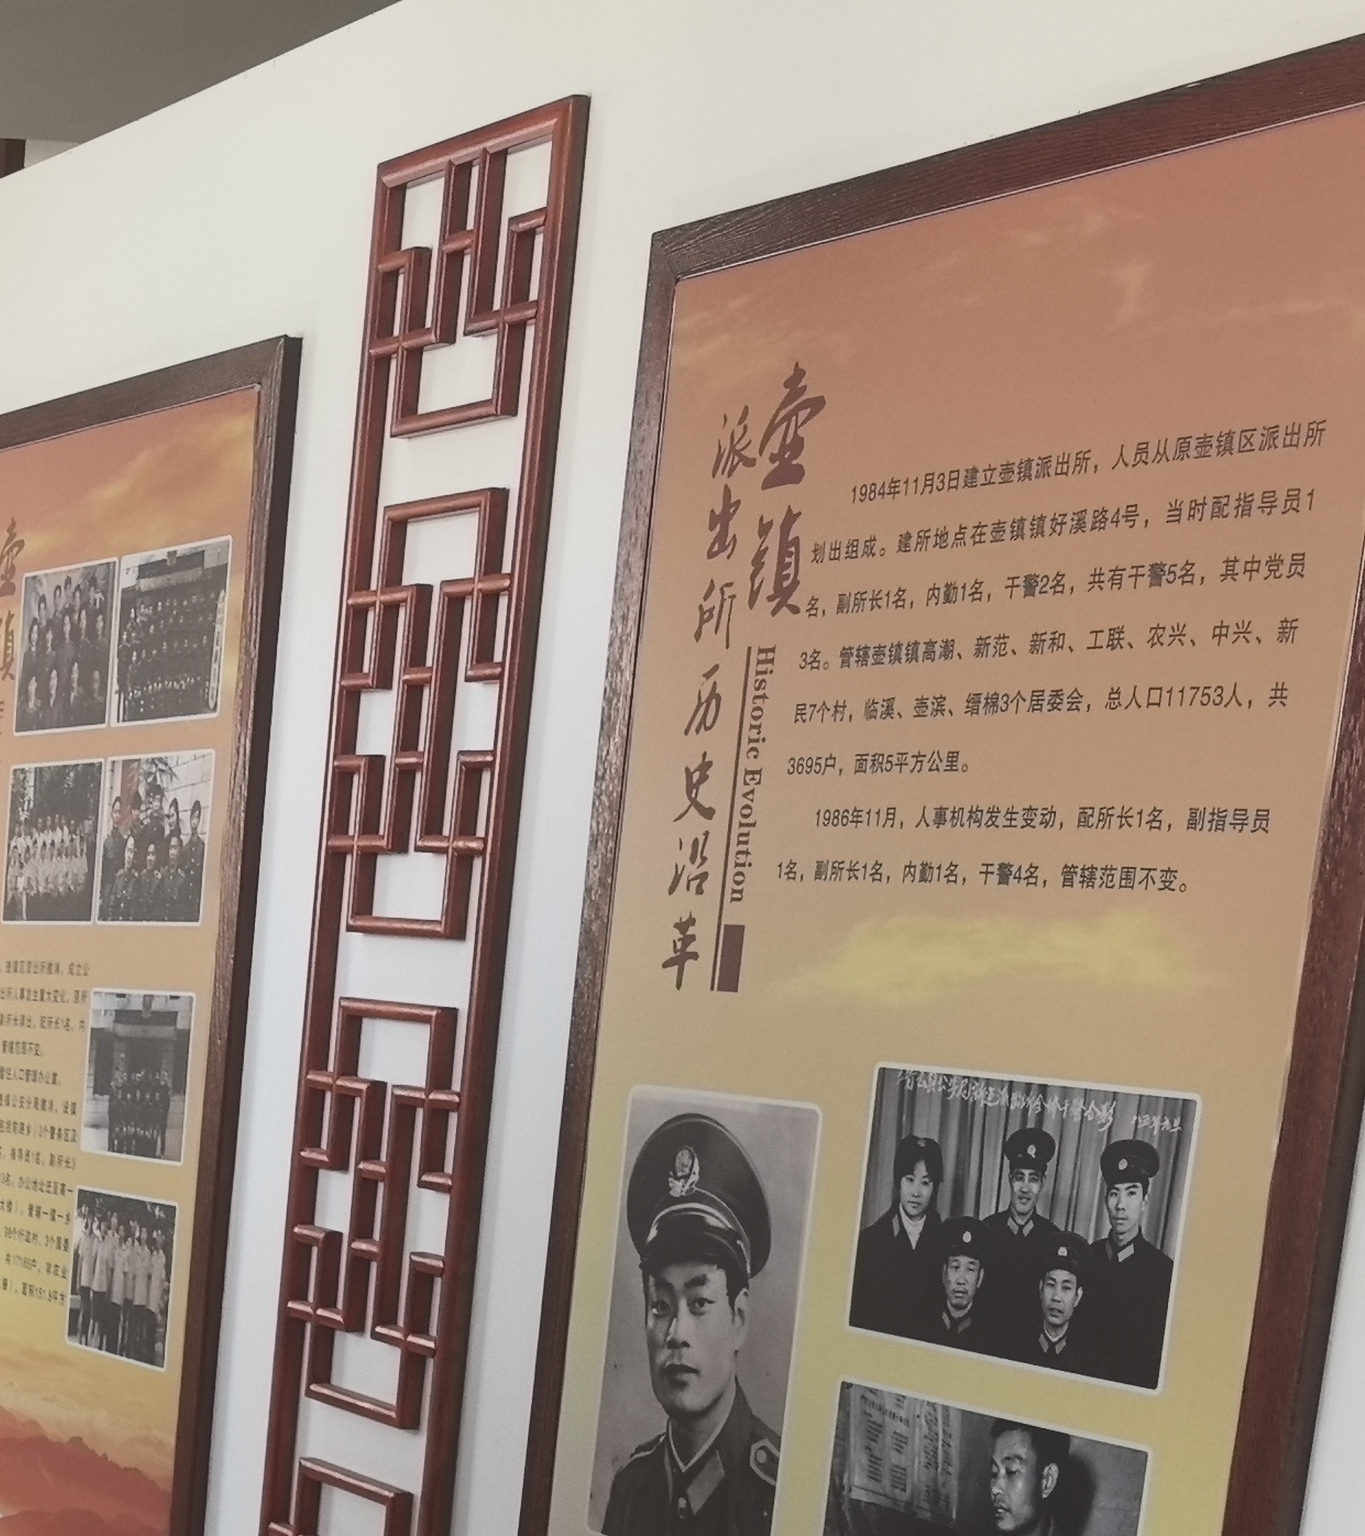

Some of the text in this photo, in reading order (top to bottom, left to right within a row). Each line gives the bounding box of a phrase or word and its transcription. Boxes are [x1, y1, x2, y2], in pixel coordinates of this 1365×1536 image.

[852, 420, 1328, 504] 1984年11月3日建立壶镇派出所，人员从原壶镇区派出所
[811, 487, 1316, 565] 划出组成。建所地点在壶镇镇好溪路4号，当时配指导员1
[729, 645, 777, 904] Historic Evolution
[787, 750, 969, 777] 3695户，面积5平方公里。
[815, 805, 1271, 834] 1986年11月，人事机构发生变动，配所长1名，副指导员
[777, 860, 1187, 893] 1名，副所长1名，内勤1名，干警4名，管辖范围不变。
